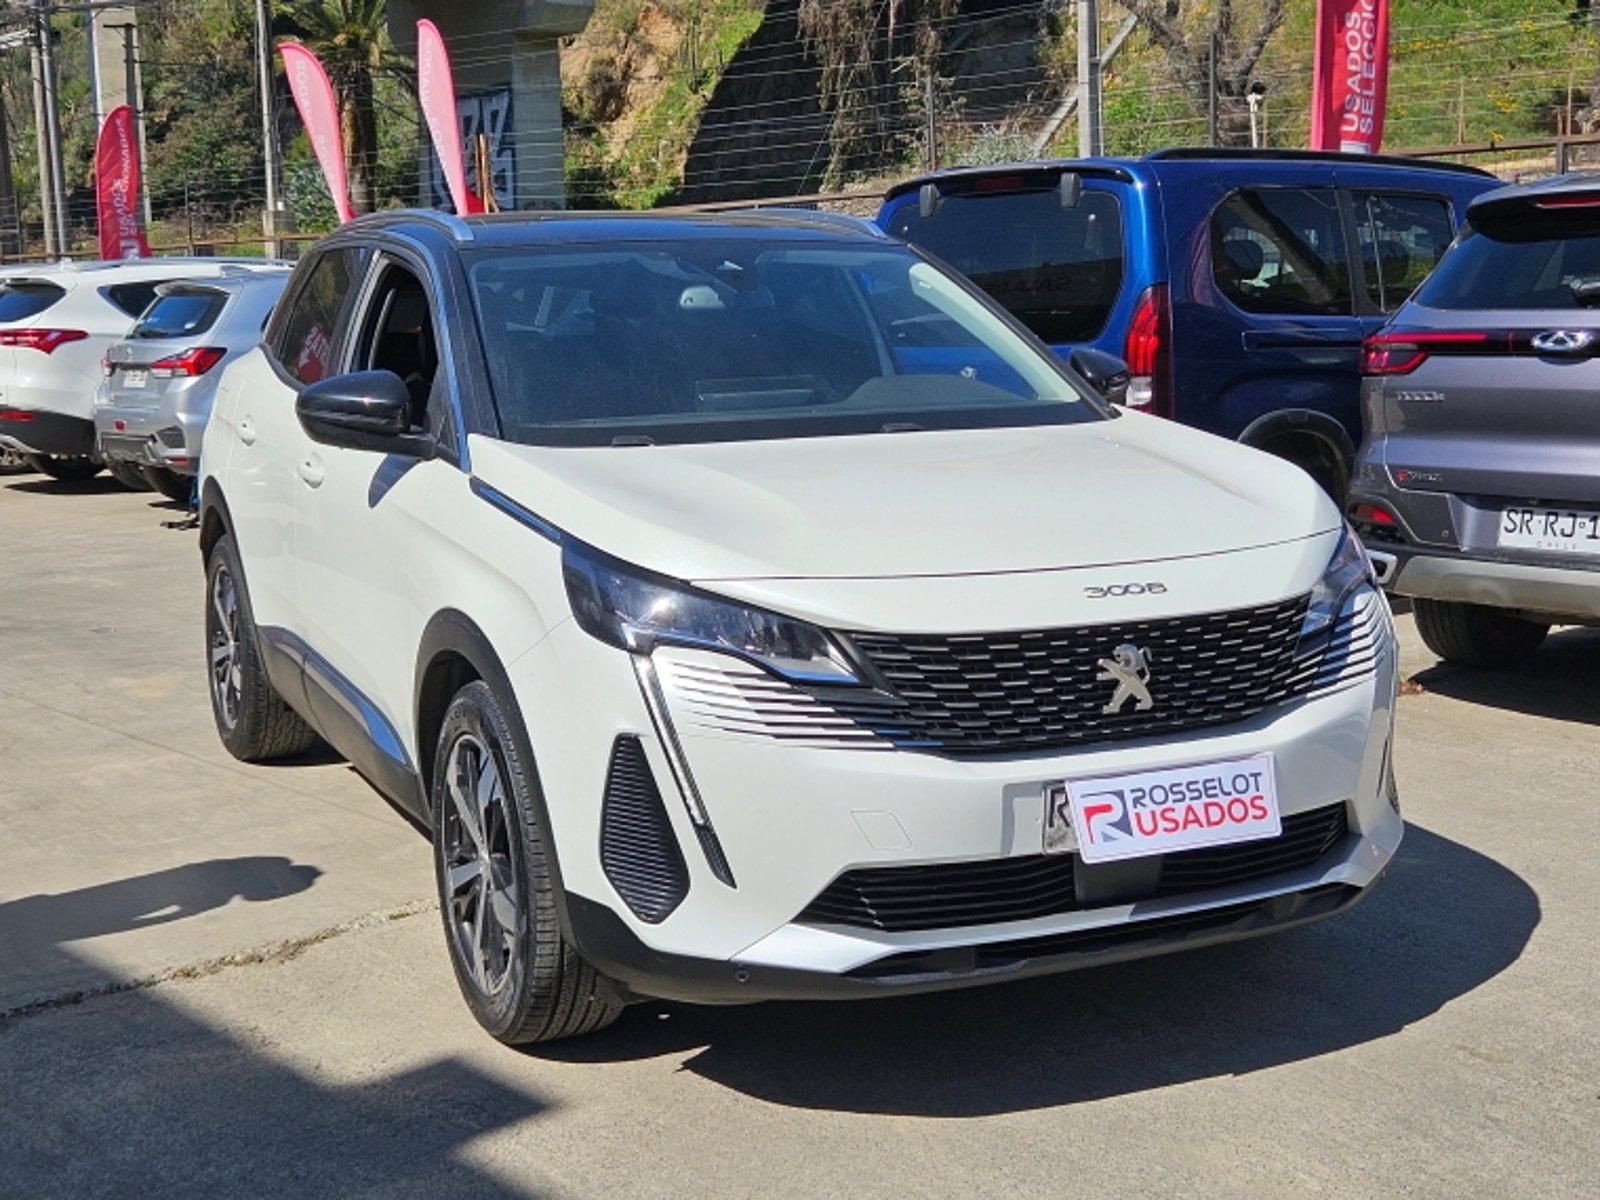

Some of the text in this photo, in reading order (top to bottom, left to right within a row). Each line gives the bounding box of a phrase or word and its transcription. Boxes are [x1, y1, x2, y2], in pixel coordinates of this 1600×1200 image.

[1341, 11, 1361, 132] USADOS
[1083, 583, 1168, 599] 3008
[1130, 772, 1263, 810] ROSSELOT
[1133, 795, 1269, 837] USADOS
